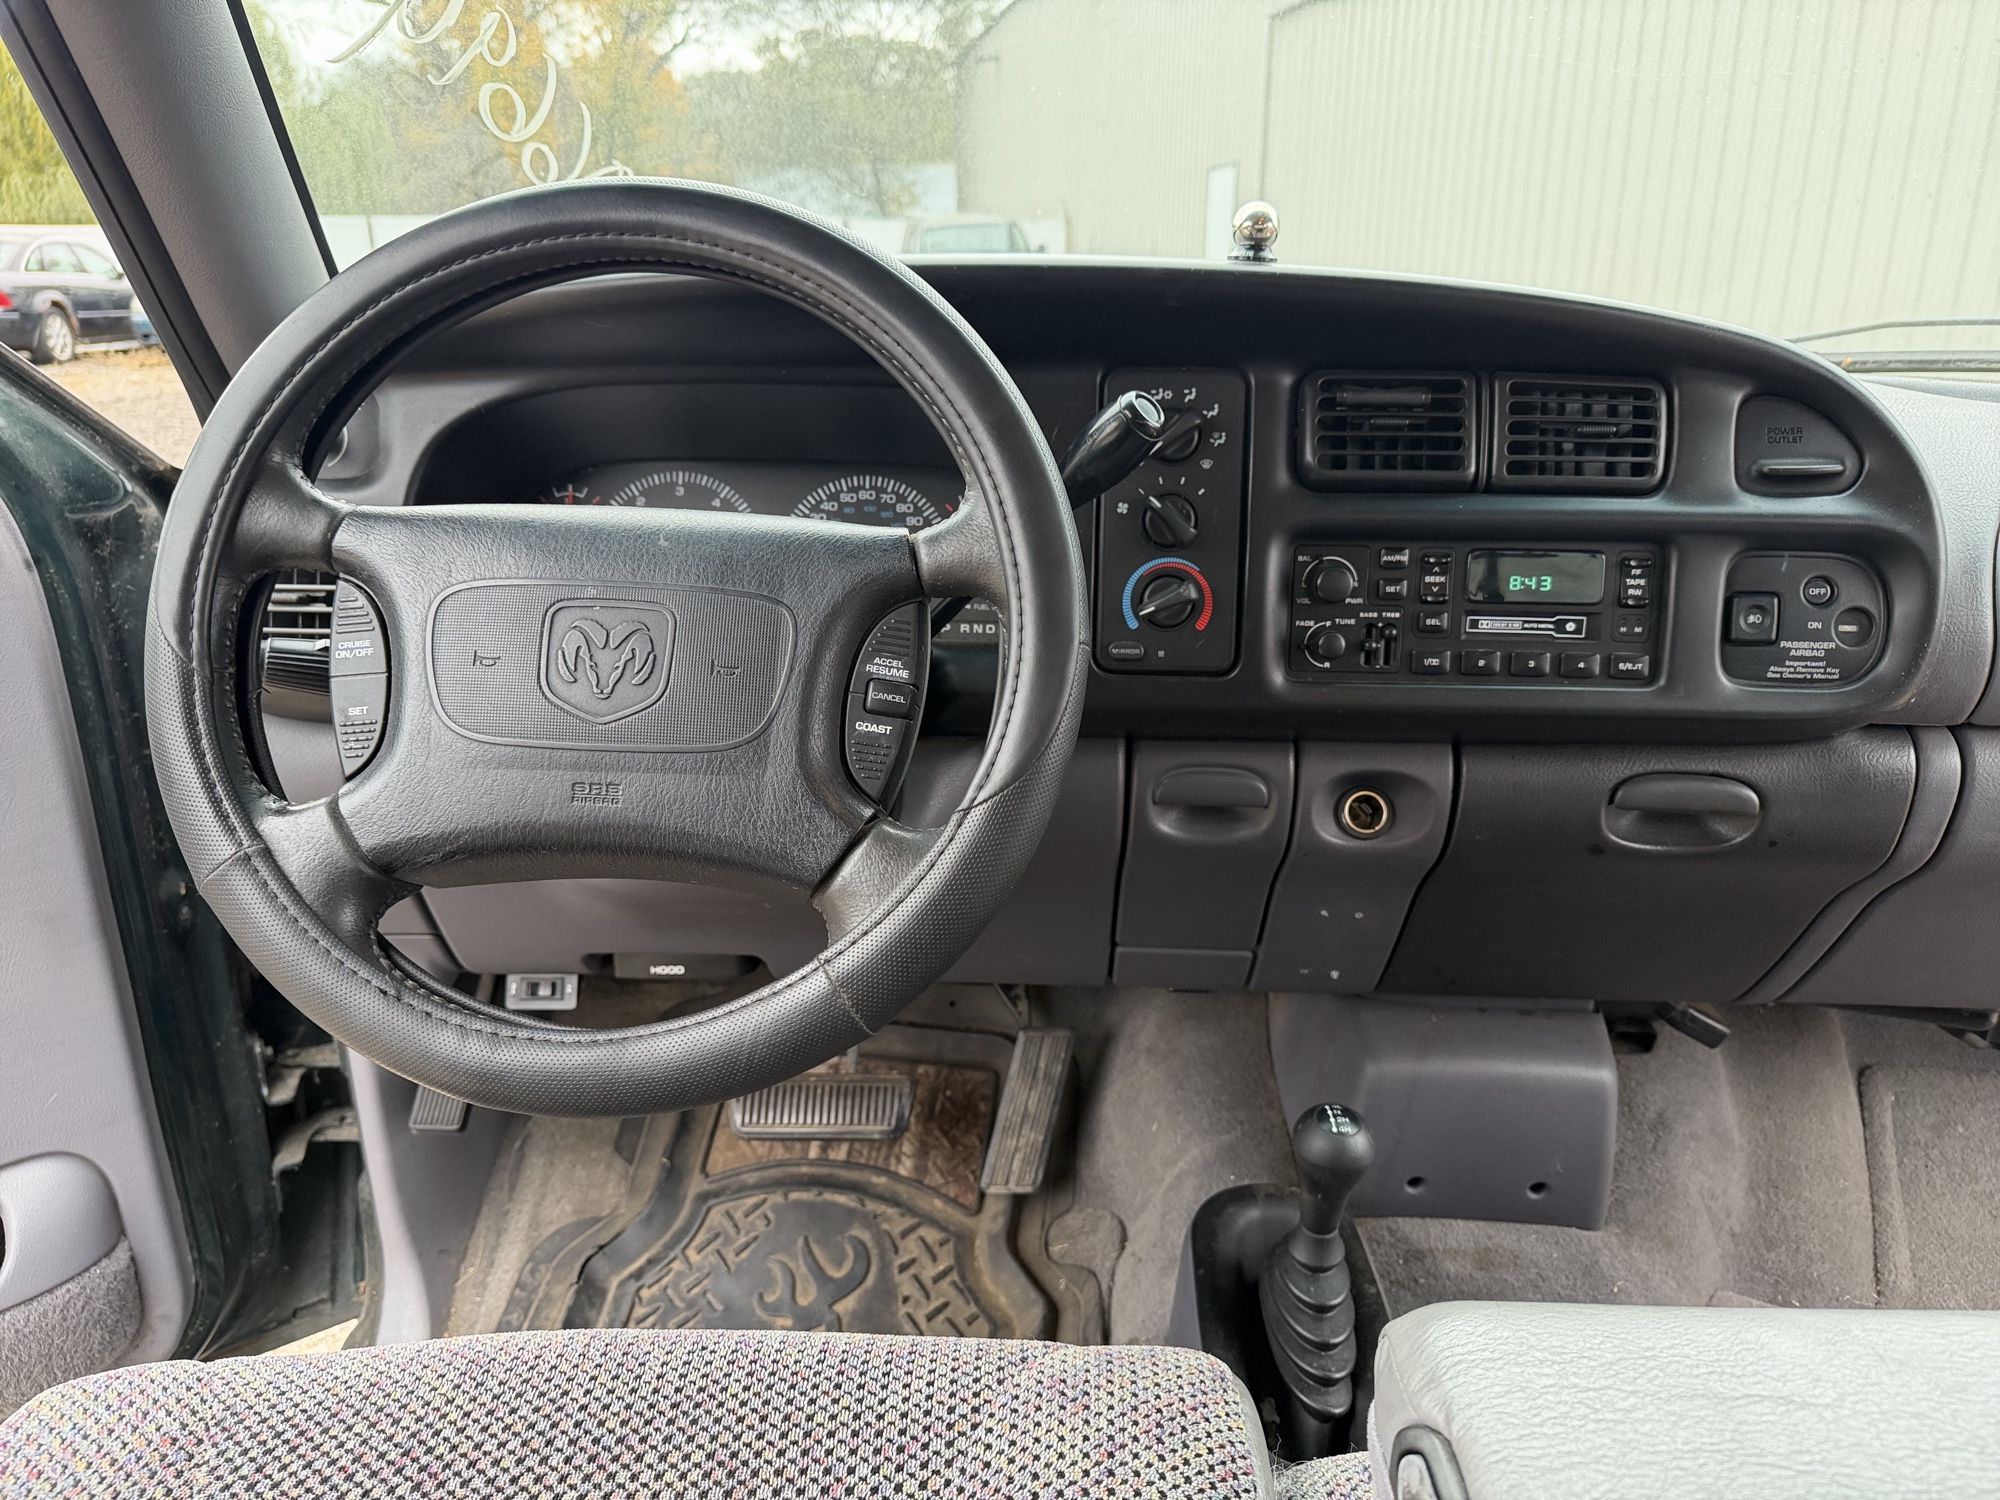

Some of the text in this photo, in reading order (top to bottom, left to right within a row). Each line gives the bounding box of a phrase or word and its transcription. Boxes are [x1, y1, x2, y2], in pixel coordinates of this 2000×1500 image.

[1766, 427, 1803, 435] POWER
[1767, 436, 1803, 444] OUTLET
[635, 486, 721, 508] 2 3 4
[820, 501, 838, 511] 40
[839, 493, 857, 503] 50
[858, 490, 876, 500] 60
[879, 494, 896, 503] 70
[896, 503, 914, 513] 80
[906, 516, 923, 526] 90
[1424, 575, 1446, 583] SEEK
[1509, 575, 1552, 591] 8:43
[1625, 578, 1646, 586] TAPE
[1627, 588, 1643, 596] RW
[1809, 587, 1827, 596] OFF
[973, 603, 990, 611] FUEL
[960, 624, 970, 634] R
[973, 624, 983, 634] N
[986, 624, 996, 634] D
[1808, 622, 1822, 630] ON
[338, 639, 371, 649] CRUISE
[1780, 641, 1836, 649] PASSENGER
[335, 648, 374, 659] ON/OFF
[1789, 649, 1825, 657] AIRBAG
[873, 657, 904, 668] ACCEL
[1478, 659, 1486, 667] 2
[1528, 660, 1535, 668] 3
[1577, 660, 1585, 669] 4
[1618, 662, 1643, 671] 5/EJT
[866, 664, 909, 678] RESUME
[1768, 665, 1795, 673] Always
[871, 691, 907, 703] CANCEL
[348, 706, 369, 716] SET
[855, 721, 893, 735] COAST
[650, 965, 685, 975] HOOD
